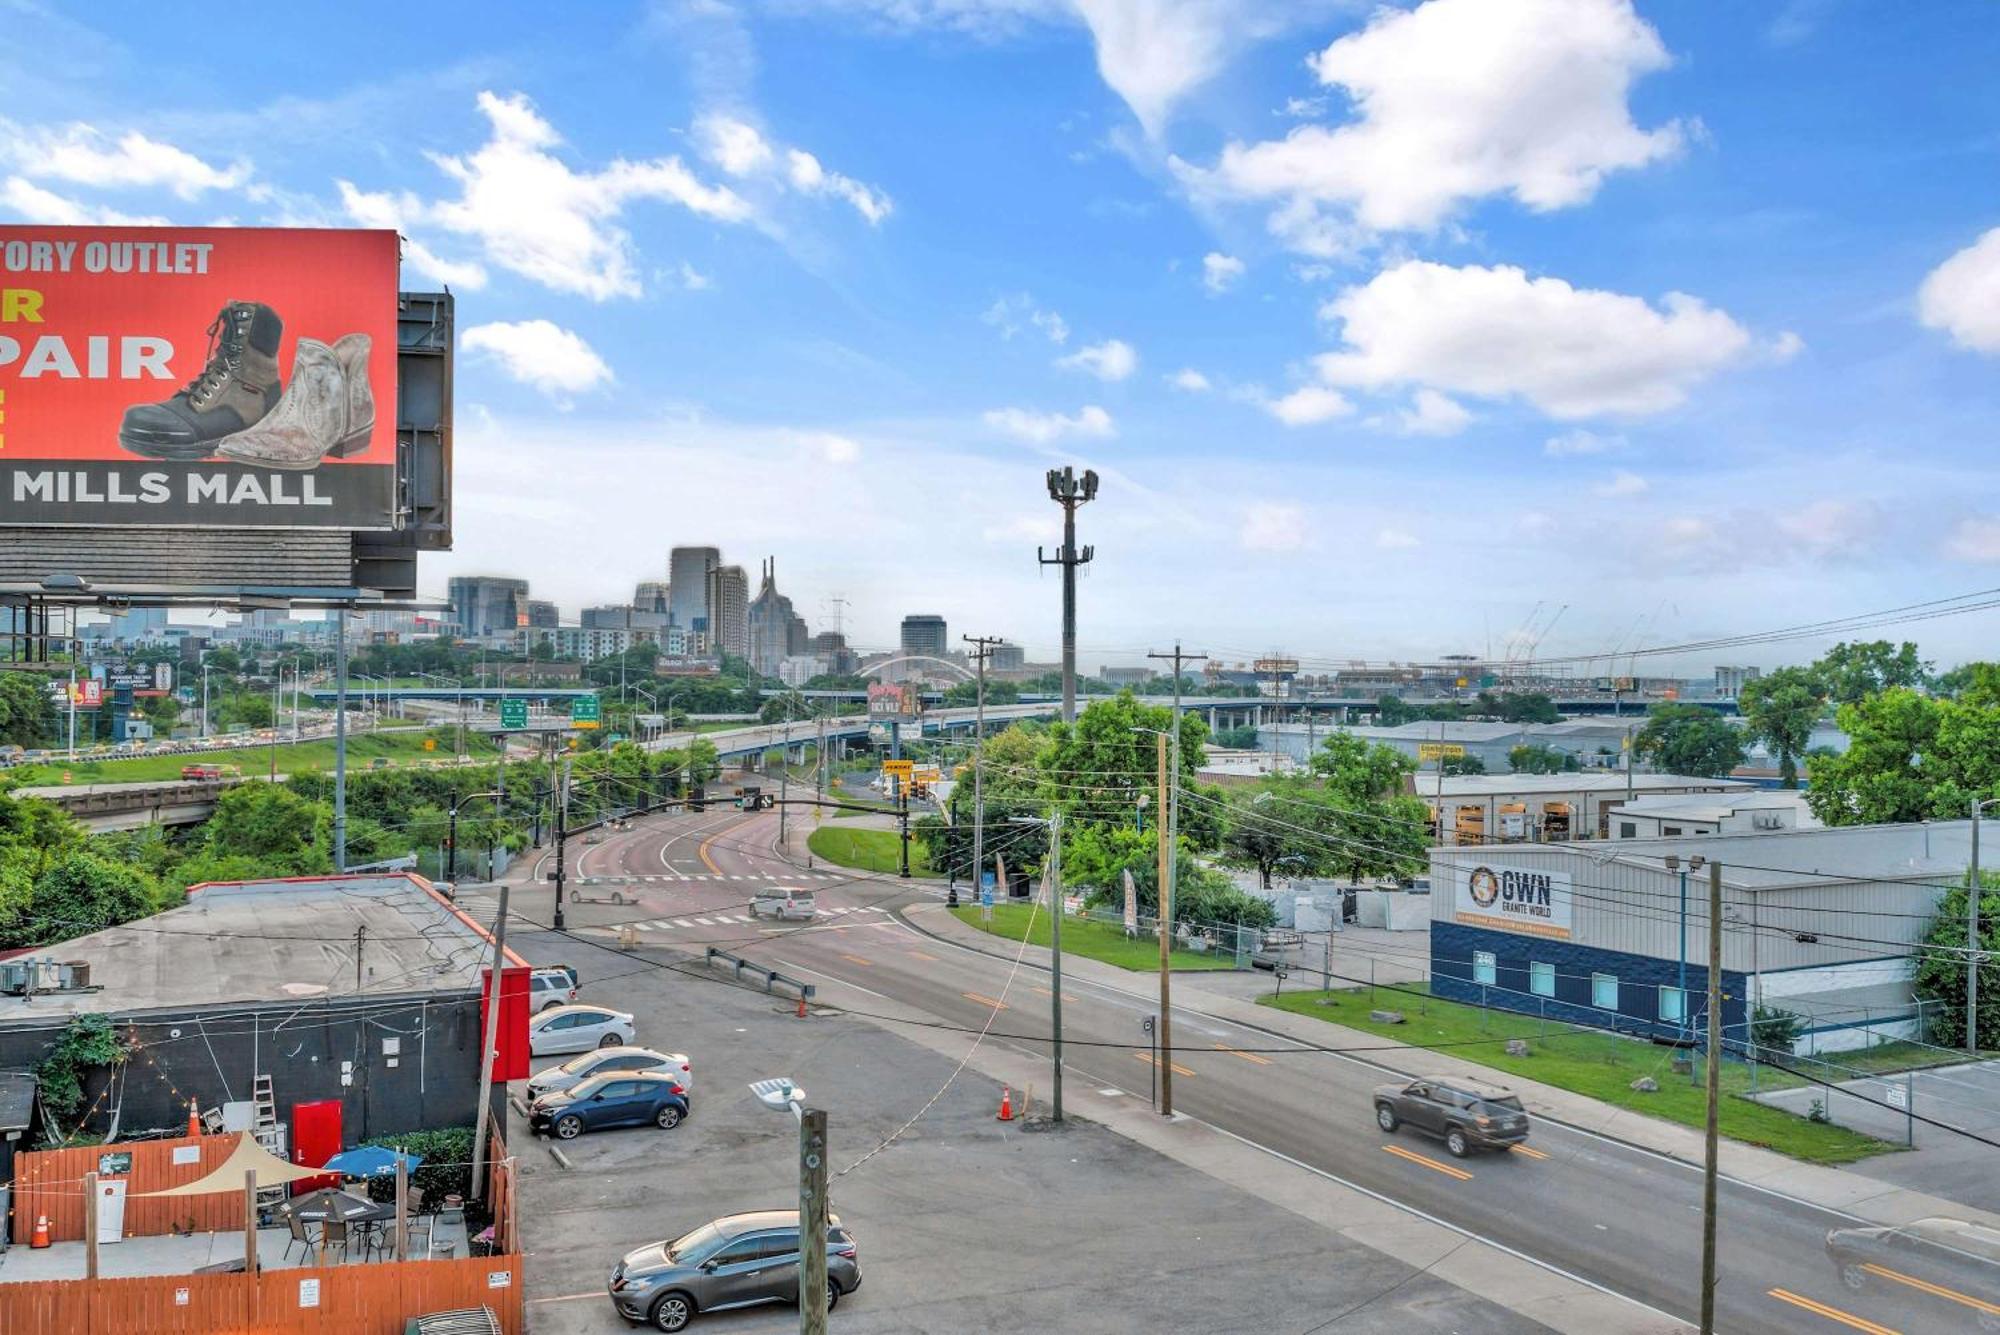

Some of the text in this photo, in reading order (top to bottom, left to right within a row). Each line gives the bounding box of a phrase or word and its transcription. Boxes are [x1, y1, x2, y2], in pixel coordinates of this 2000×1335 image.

[0, 241, 213, 274] ORY OUTLET
[13, 471, 332, 505] MILLS MALL
[1502, 870, 1551, 906] GWN
[1502, 901, 1552, 918] GRANITE WORLD
